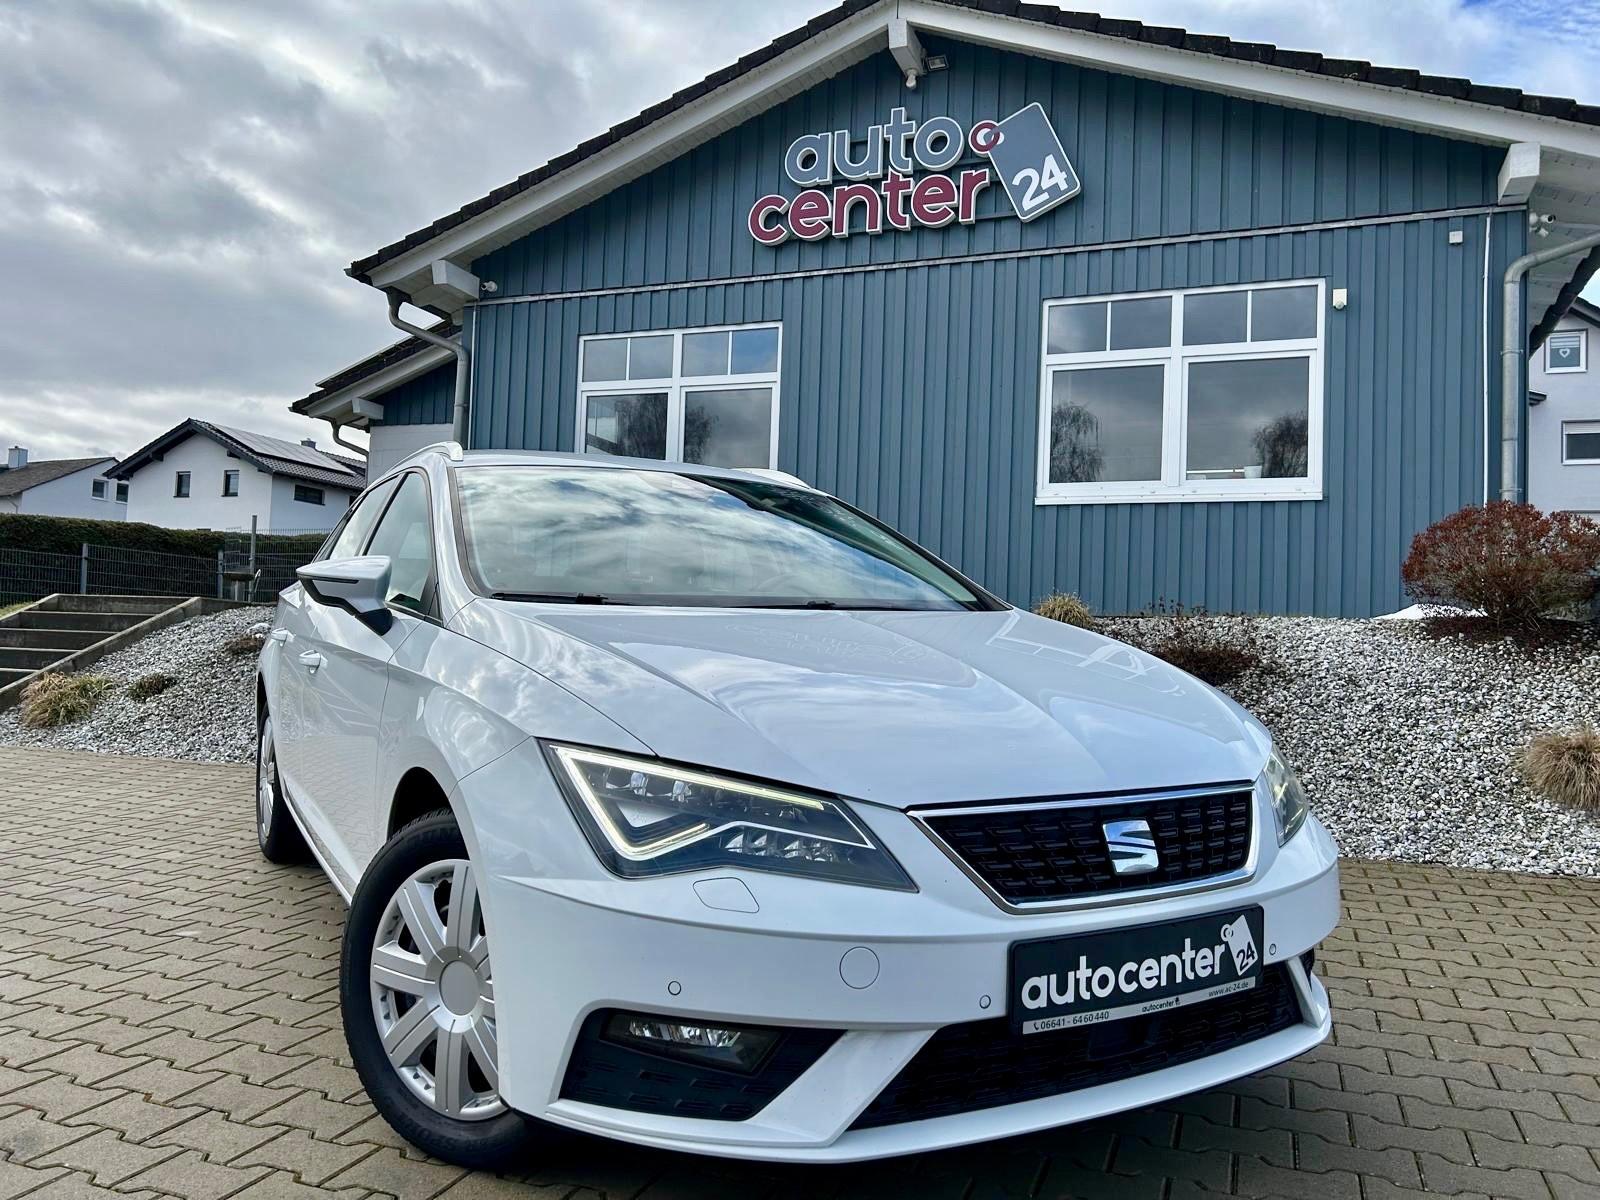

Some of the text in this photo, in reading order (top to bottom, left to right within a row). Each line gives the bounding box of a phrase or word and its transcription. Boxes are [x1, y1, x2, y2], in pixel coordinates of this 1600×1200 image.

[785, 107, 964, 187] auto
[748, 166, 990, 246] center
[1012, 154, 1068, 211] 24
[1021, 938, 1256, 1010] autocenter 24
[1142, 999, 1175, 1012] autocenter
[1040, 1018, 1065, 1030] 06641
